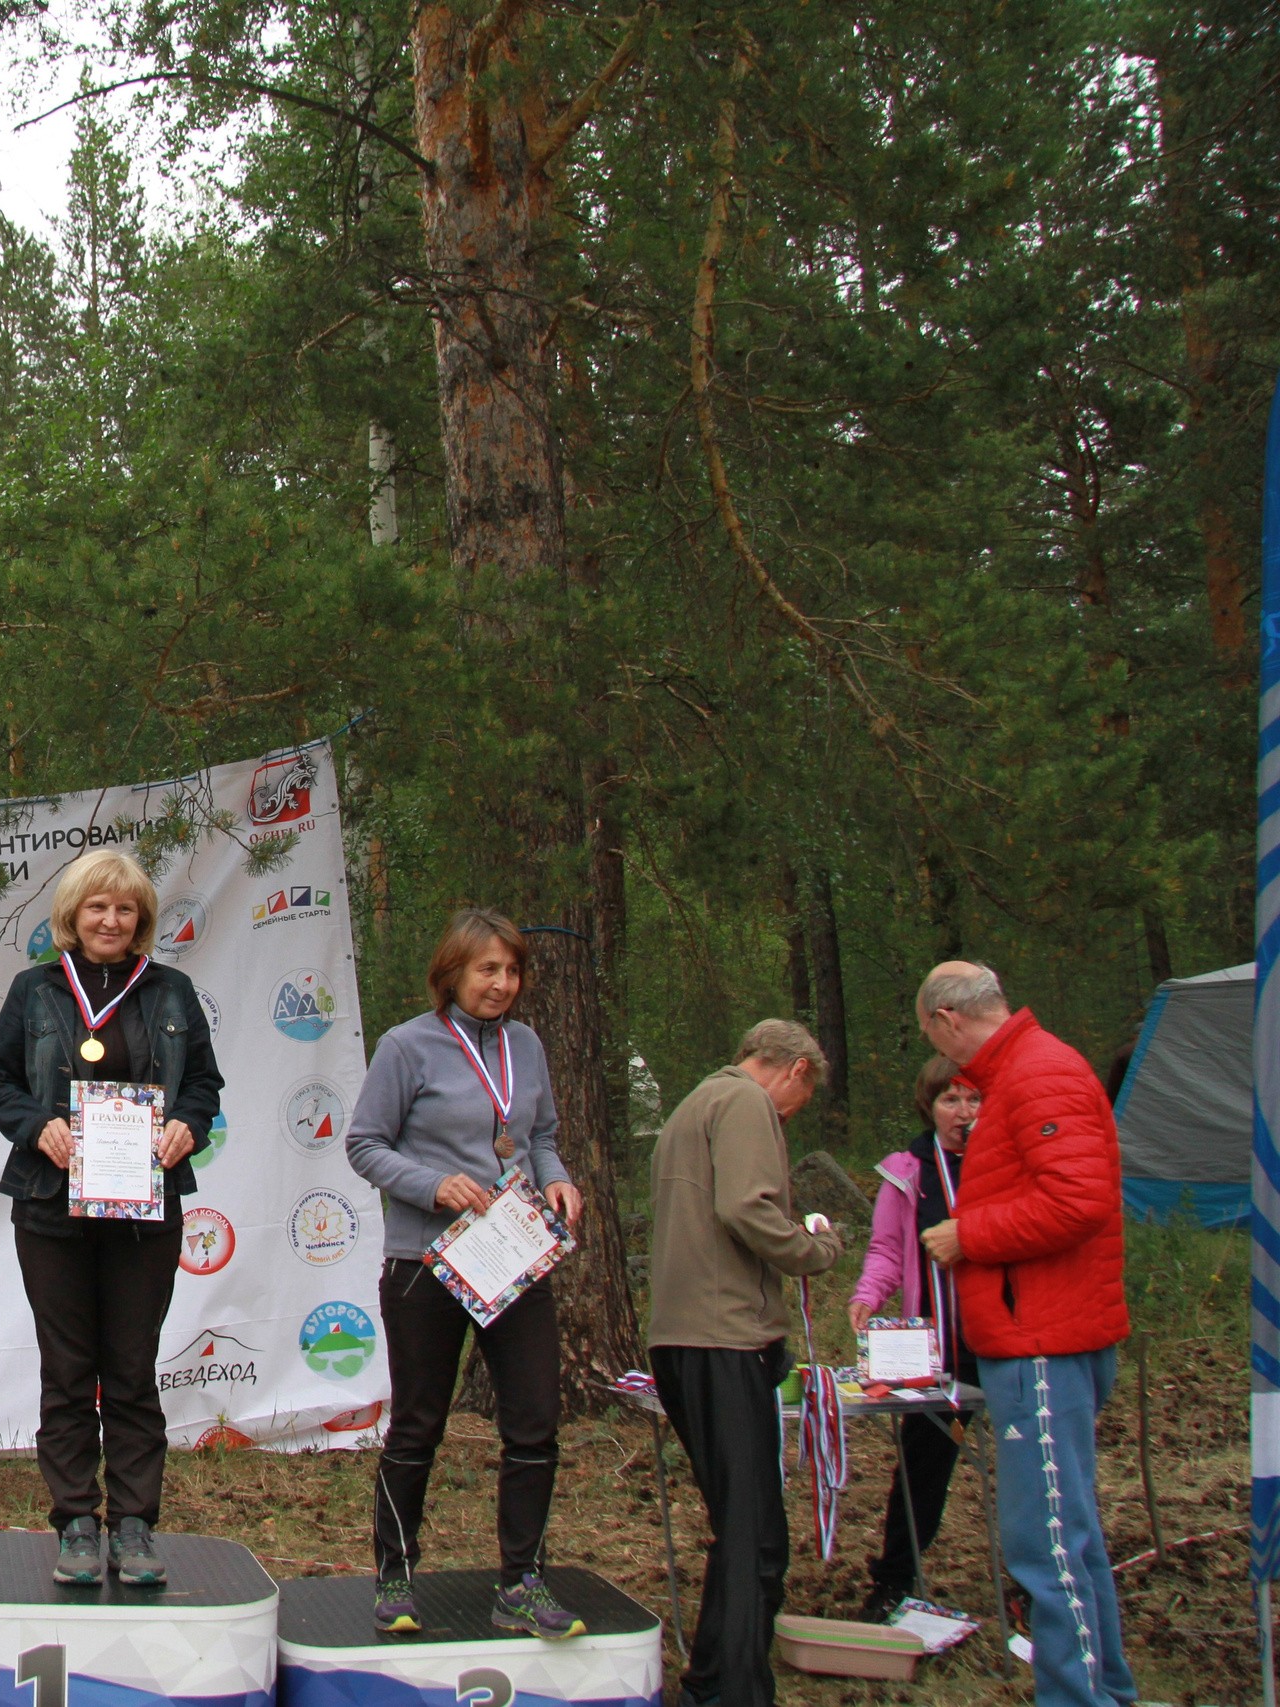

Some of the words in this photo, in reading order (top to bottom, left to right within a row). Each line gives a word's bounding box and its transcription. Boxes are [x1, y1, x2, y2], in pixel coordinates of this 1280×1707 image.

[252, 914, 297, 930] СЕМЕЙНЫЕ
[298, 909, 331, 919] СТАРТЫ
[201, 993, 218, 1014] СШОР
[91, 1112, 145, 1124] ГРАМОТА
[200, 1209, 229, 1229] КОРОЛЬ
[291, 1209, 300, 1248] Открытое
[298, 1191, 336, 1208] первенство
[337, 1198, 355, 1220] СШОР
[502, 1201, 544, 1248] ГРАМОТА
[305, 1241, 345, 1250] Челябинск
[158, 1361, 258, 1392] ВЕЗДЕХОД
[15, 1643, 68, 1707] 1
